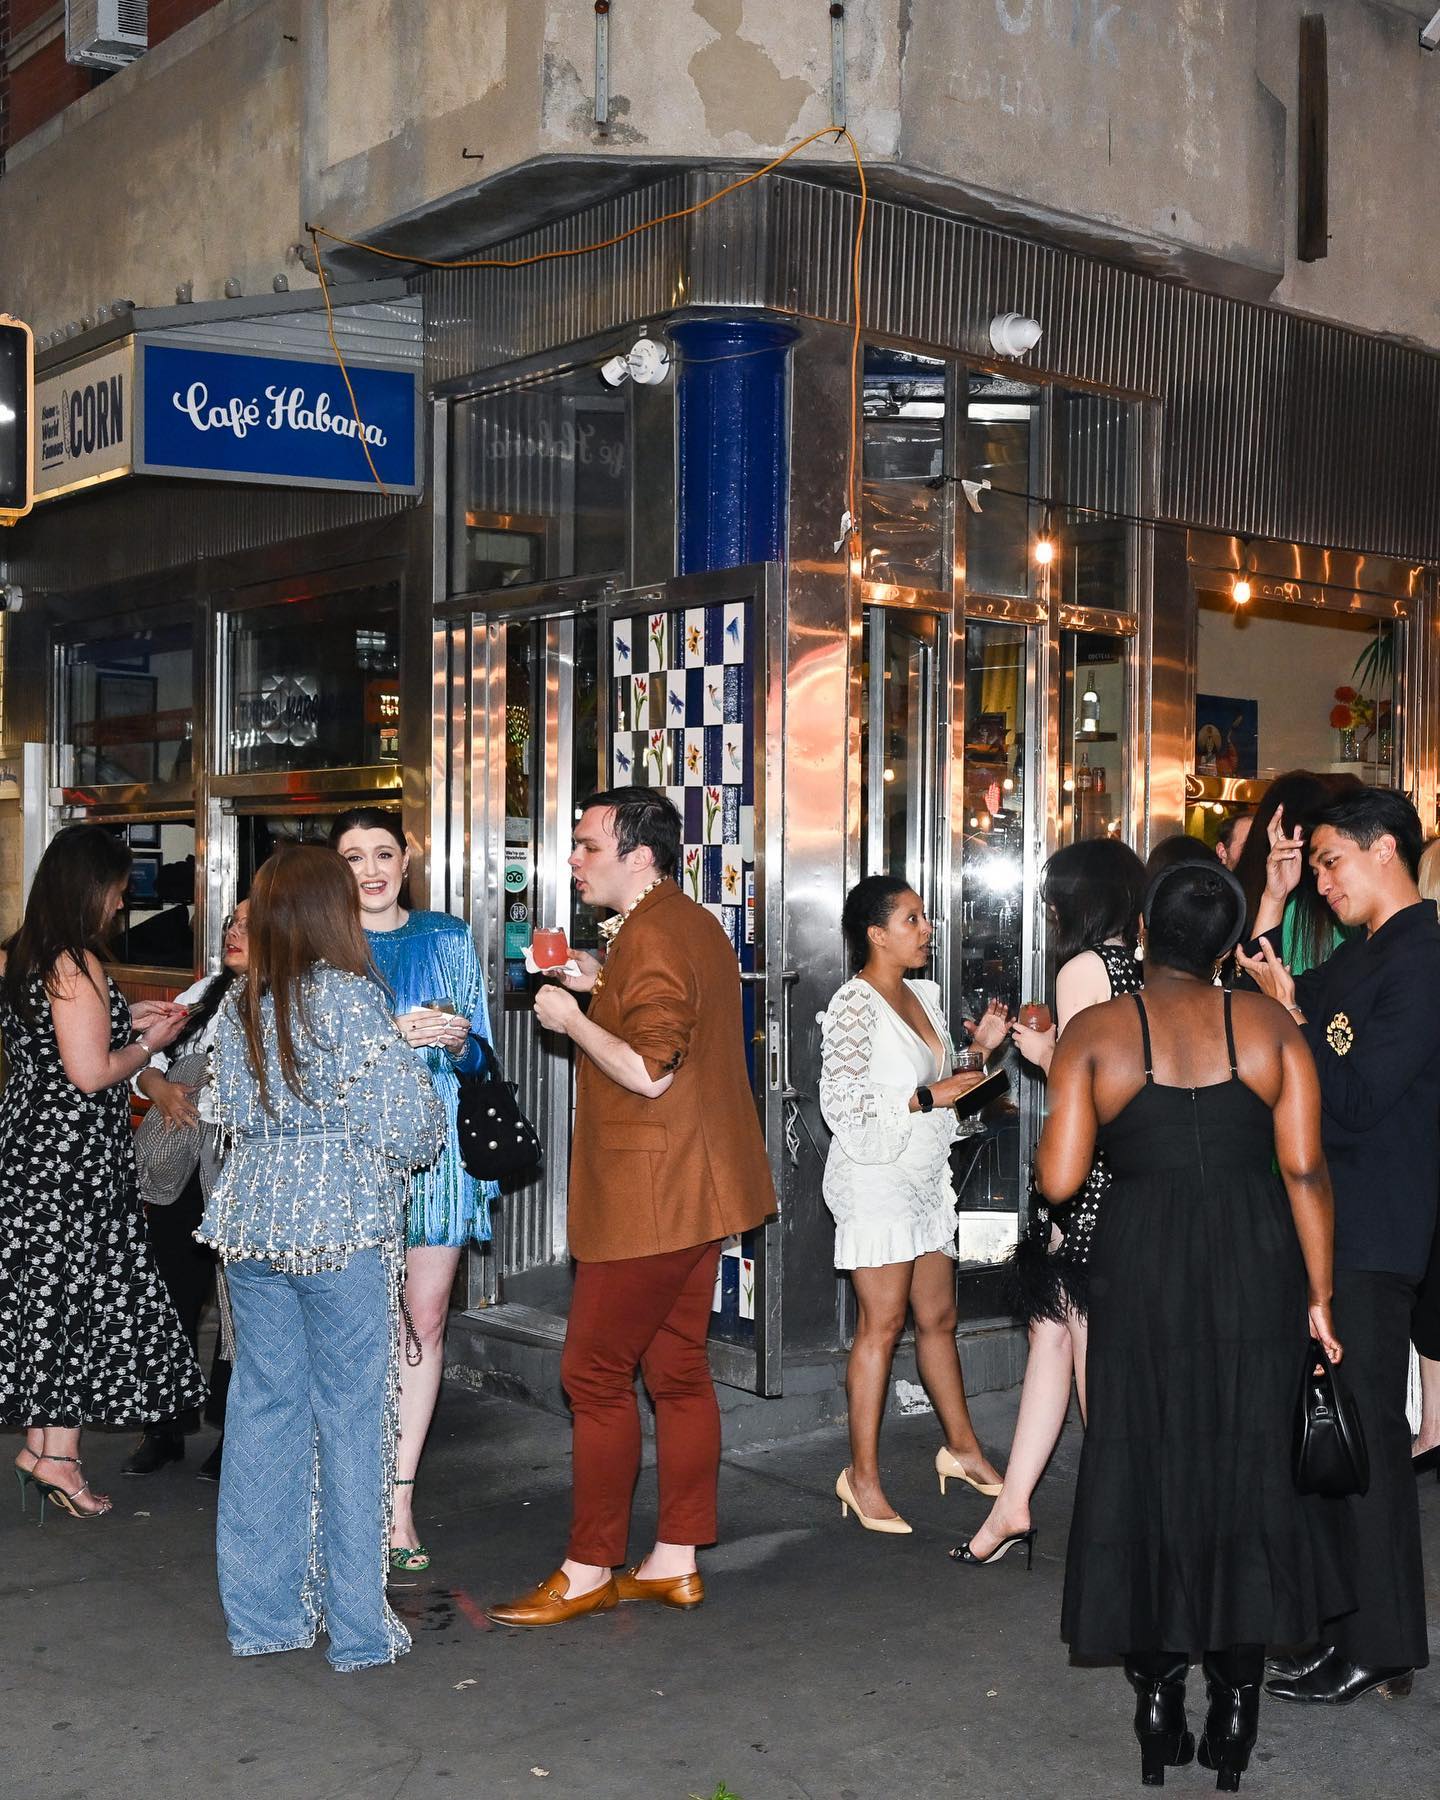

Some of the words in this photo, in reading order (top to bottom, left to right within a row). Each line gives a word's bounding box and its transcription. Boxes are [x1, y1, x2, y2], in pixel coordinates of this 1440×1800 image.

[42, 418, 60, 441] World
[70, 374, 123, 458] CORN
[172, 381, 260, 439] Café
[265, 385, 387, 447] Habana
[42, 441, 64, 461] Famous
